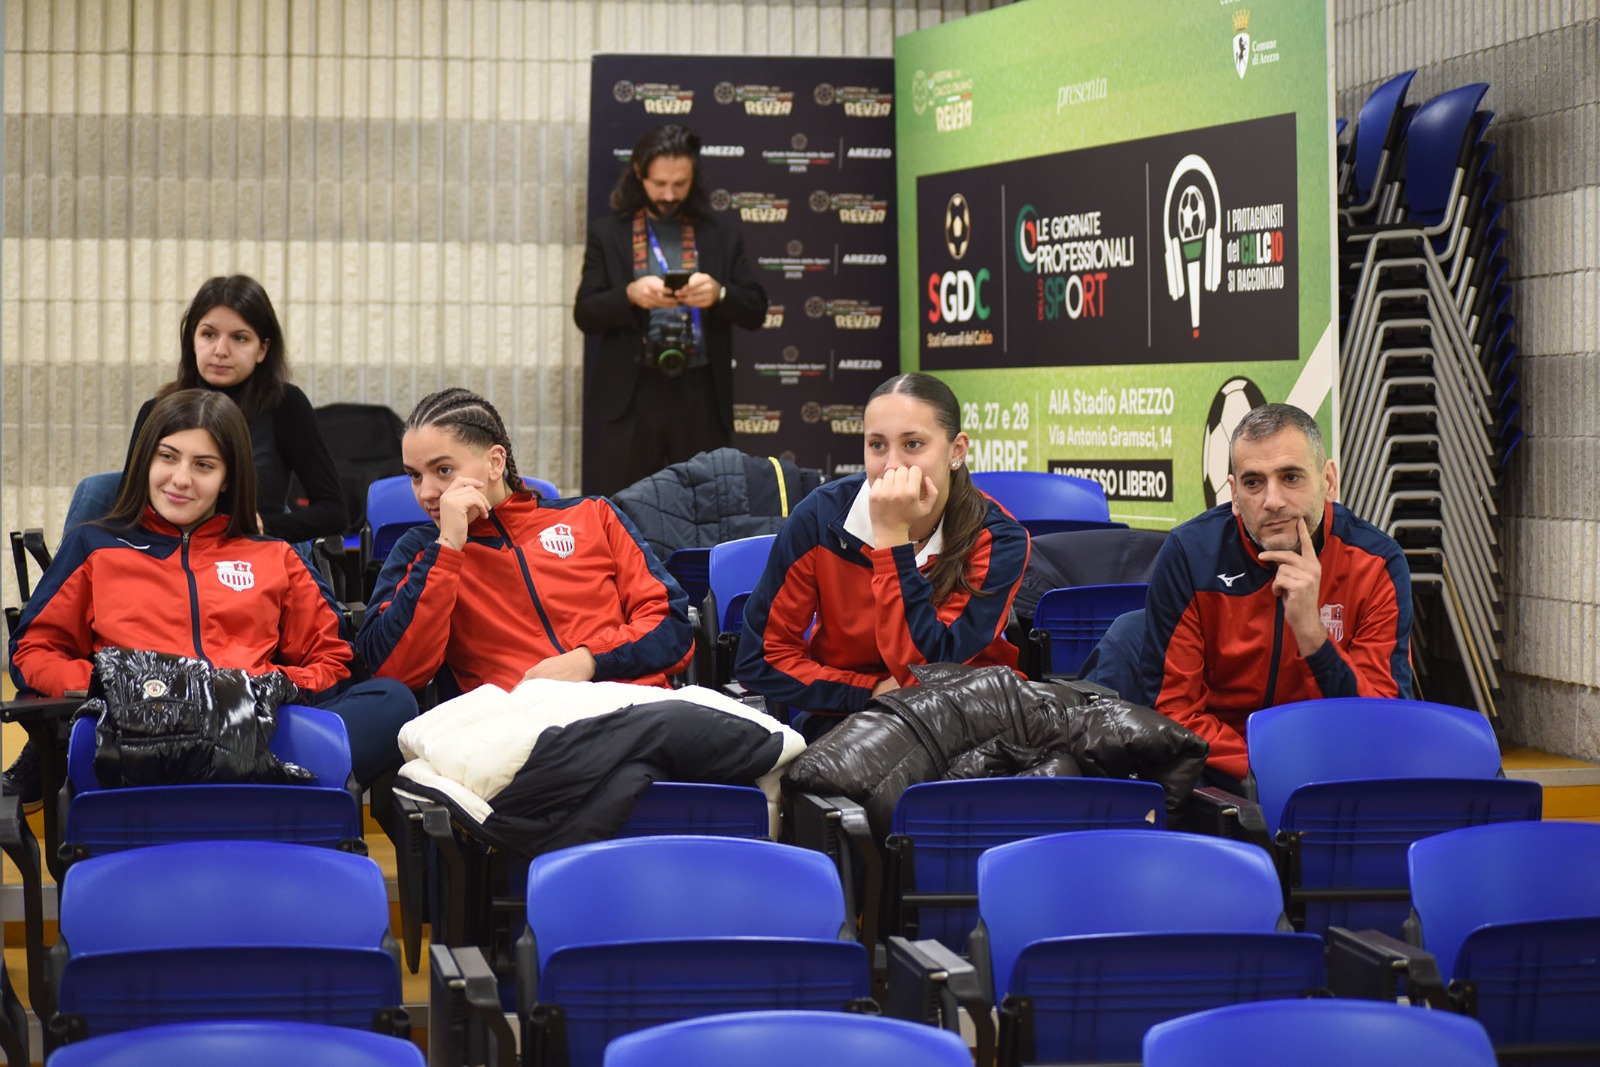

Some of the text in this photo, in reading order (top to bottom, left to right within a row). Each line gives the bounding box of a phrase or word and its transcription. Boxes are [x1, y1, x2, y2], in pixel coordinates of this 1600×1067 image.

[1057, 76, 1107, 115] presenta
[699, 145, 745, 156] AREZZO
[847, 148, 892, 158] AREZZO
[1036, 211, 1101, 242] LE GIORNATE
[1227, 204, 1283, 232] I PROTAGONISTI
[842, 254, 887, 265] AREZZO
[1037, 236, 1134, 274] PROFESSIONALI
[1227, 231, 1283, 265] del CALCIO
[1227, 266, 1284, 292] SI RACCONTANO
[928, 268, 991, 324] SGDC
[1045, 273, 1108, 320] SPORT
[838, 360, 882, 370] AREZZO
[1049, 387, 1174, 415] AIA Stadio AREZZO
[963, 402, 1029, 434] 26, 27 e 28
[1049, 424, 1172, 450] Via Antonio Gramsci, 14
[966, 439, 1028, 473] EMBRE
[1119, 470, 1167, 498] LIBERO
